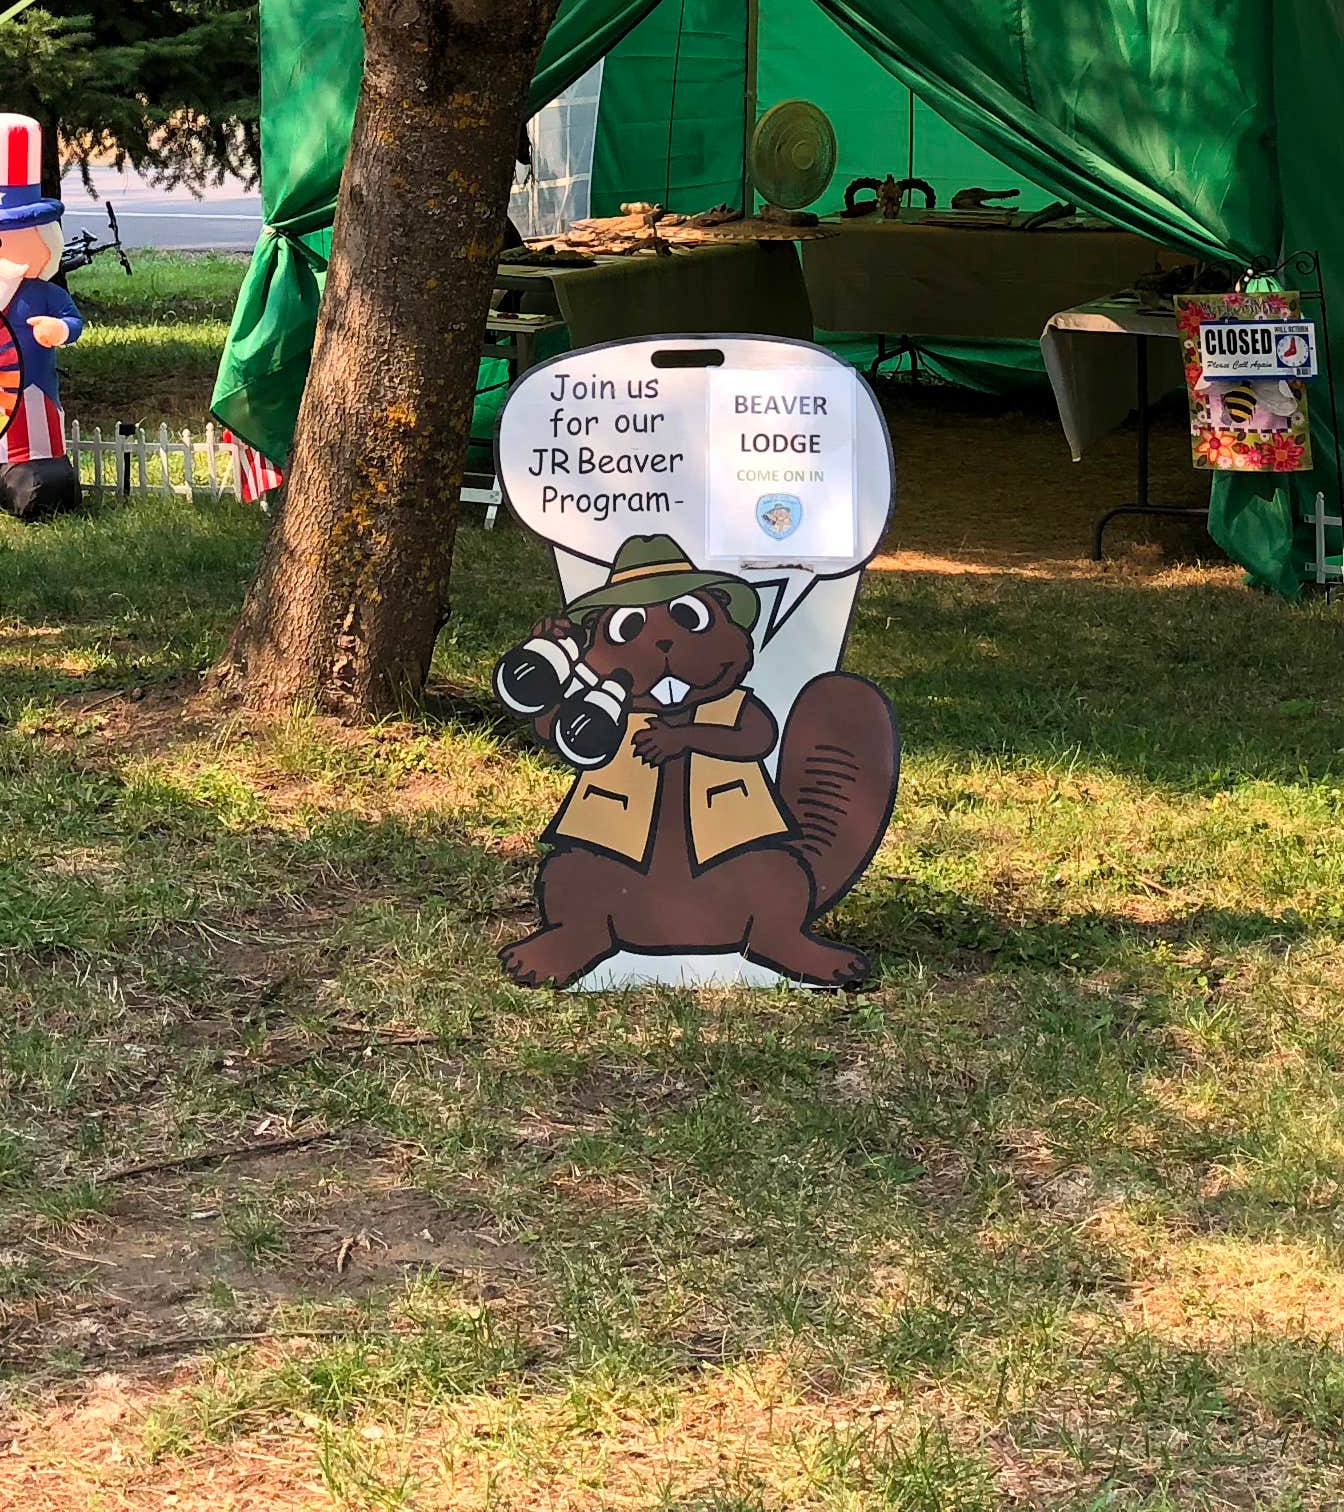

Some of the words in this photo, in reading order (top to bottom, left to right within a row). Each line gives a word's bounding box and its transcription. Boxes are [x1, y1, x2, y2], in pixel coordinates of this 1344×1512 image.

[1204, 328, 1273, 356] CLOSED
[1206, 360, 1230, 369] Please
[1250, 360, 1273, 371] Again
[550, 373, 616, 402] Join
[627, 377, 660, 399] us
[734, 394, 828, 416] BEAVER
[549, 407, 599, 438] for
[614, 413, 665, 434] our
[741, 433, 821, 454] LODGE
[528, 447, 570, 477] JR
[578, 446, 684, 475] Beaver
[736, 470, 779, 482] COME
[783, 470, 805, 482] ON
[809, 470, 825, 483] IN
